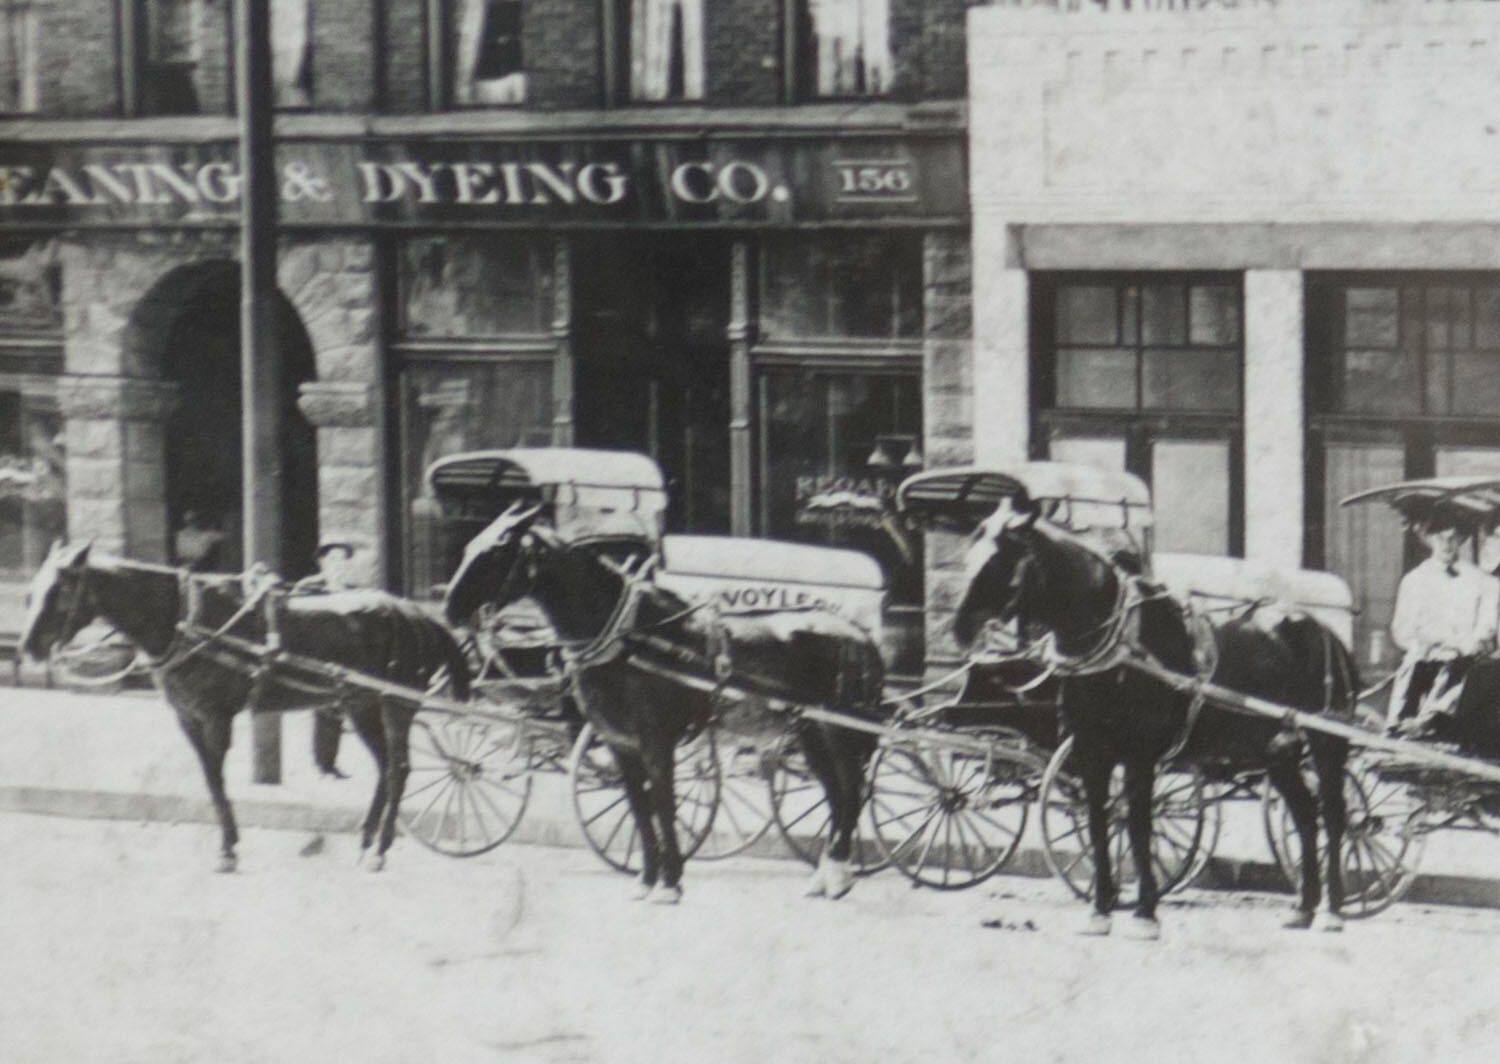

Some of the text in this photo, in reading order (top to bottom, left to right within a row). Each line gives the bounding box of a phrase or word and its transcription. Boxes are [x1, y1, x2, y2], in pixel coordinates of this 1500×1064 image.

[280, 161, 334, 203] &
[356, 162, 627, 205] DYEING
[671, 160, 790, 203] CO.
[839, 167, 912, 193] 156
